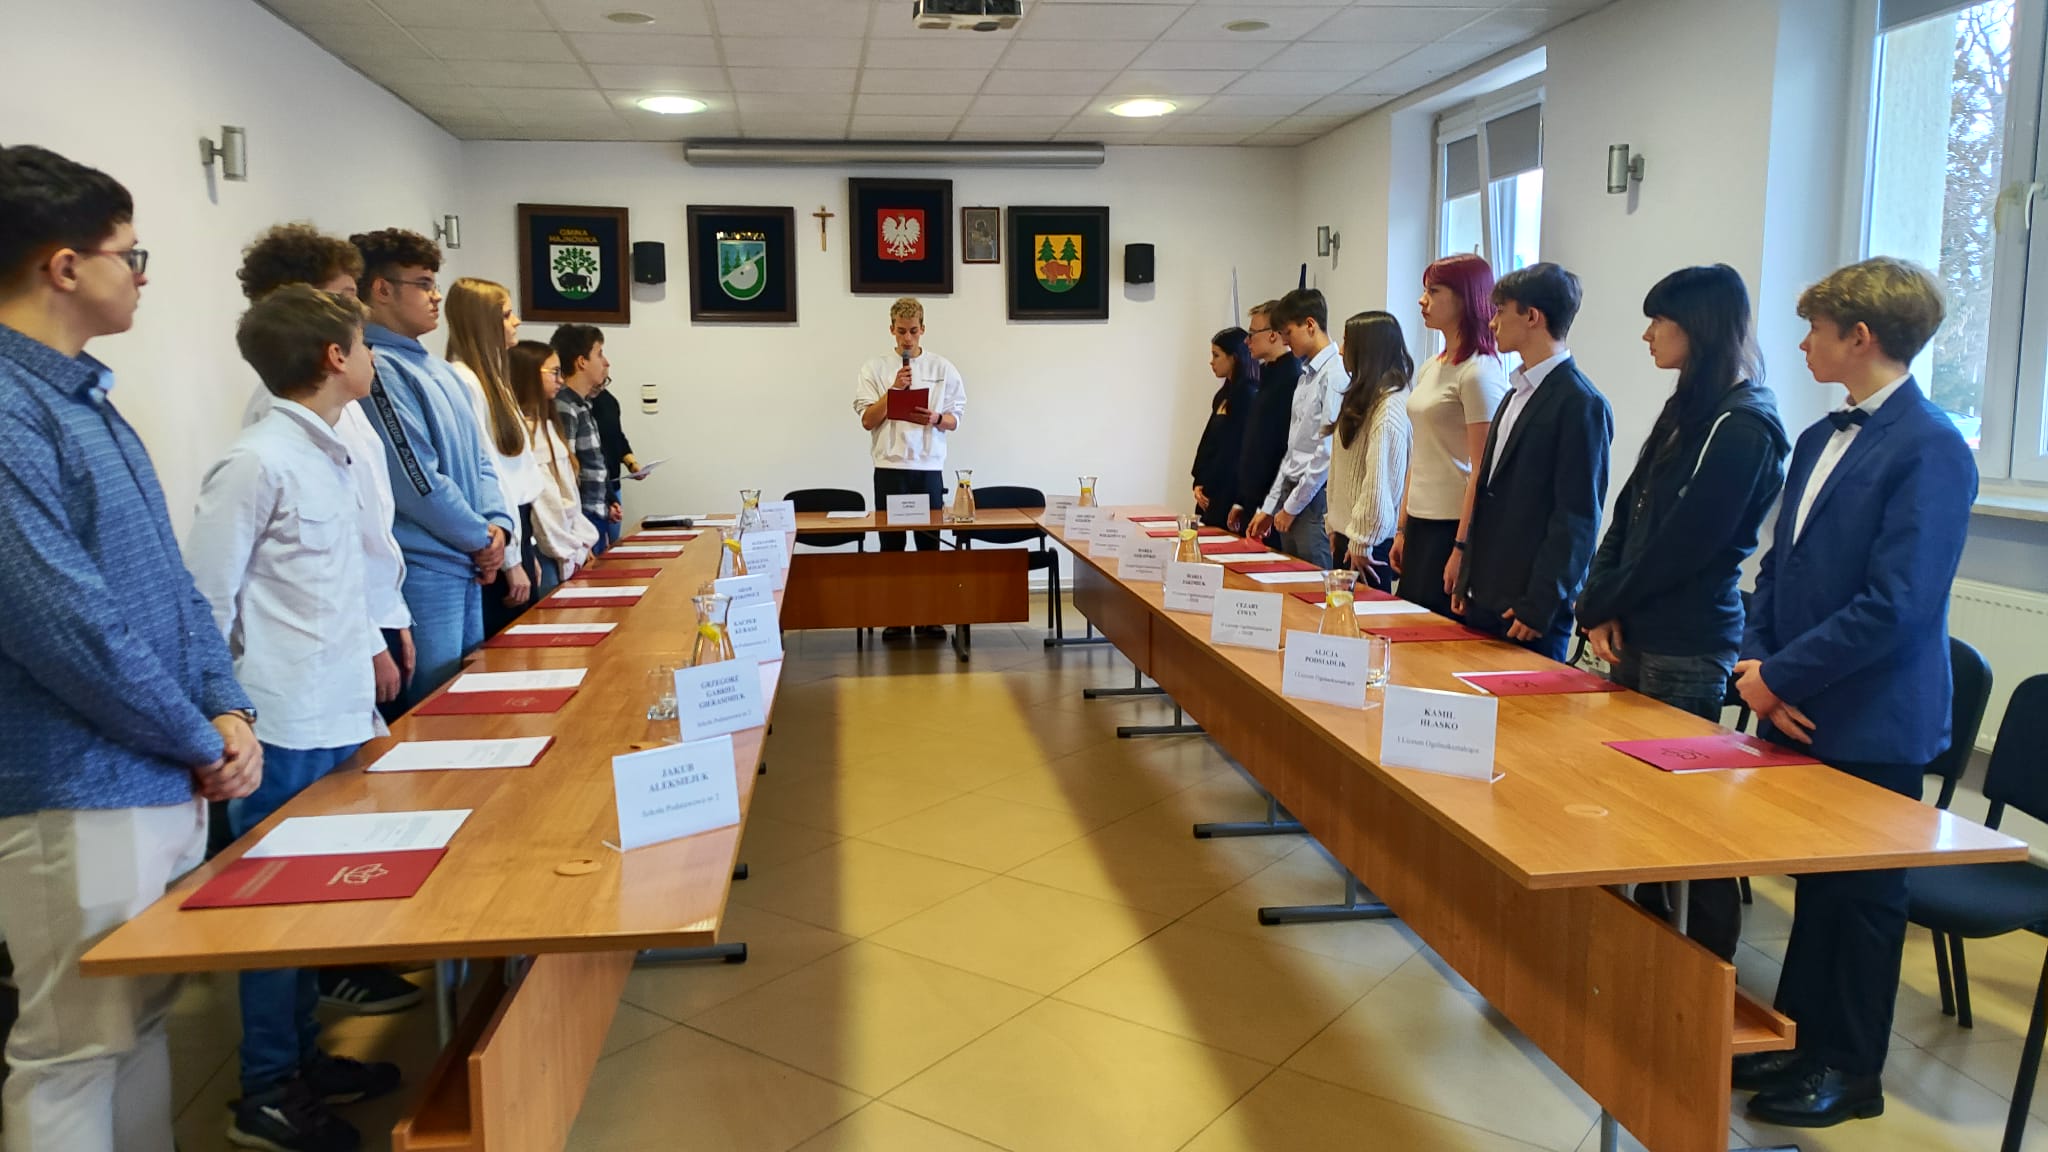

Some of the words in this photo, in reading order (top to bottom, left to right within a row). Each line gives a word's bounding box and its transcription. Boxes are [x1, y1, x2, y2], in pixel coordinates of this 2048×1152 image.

[1314, 648, 1339, 658] ALICJA
[706, 685, 736, 697] GABRIEL
[1423, 707, 1456, 720] KAMIL
[661, 762, 695, 778] JAKUB
[648, 773, 709, 793] ALEKSIEJUK
